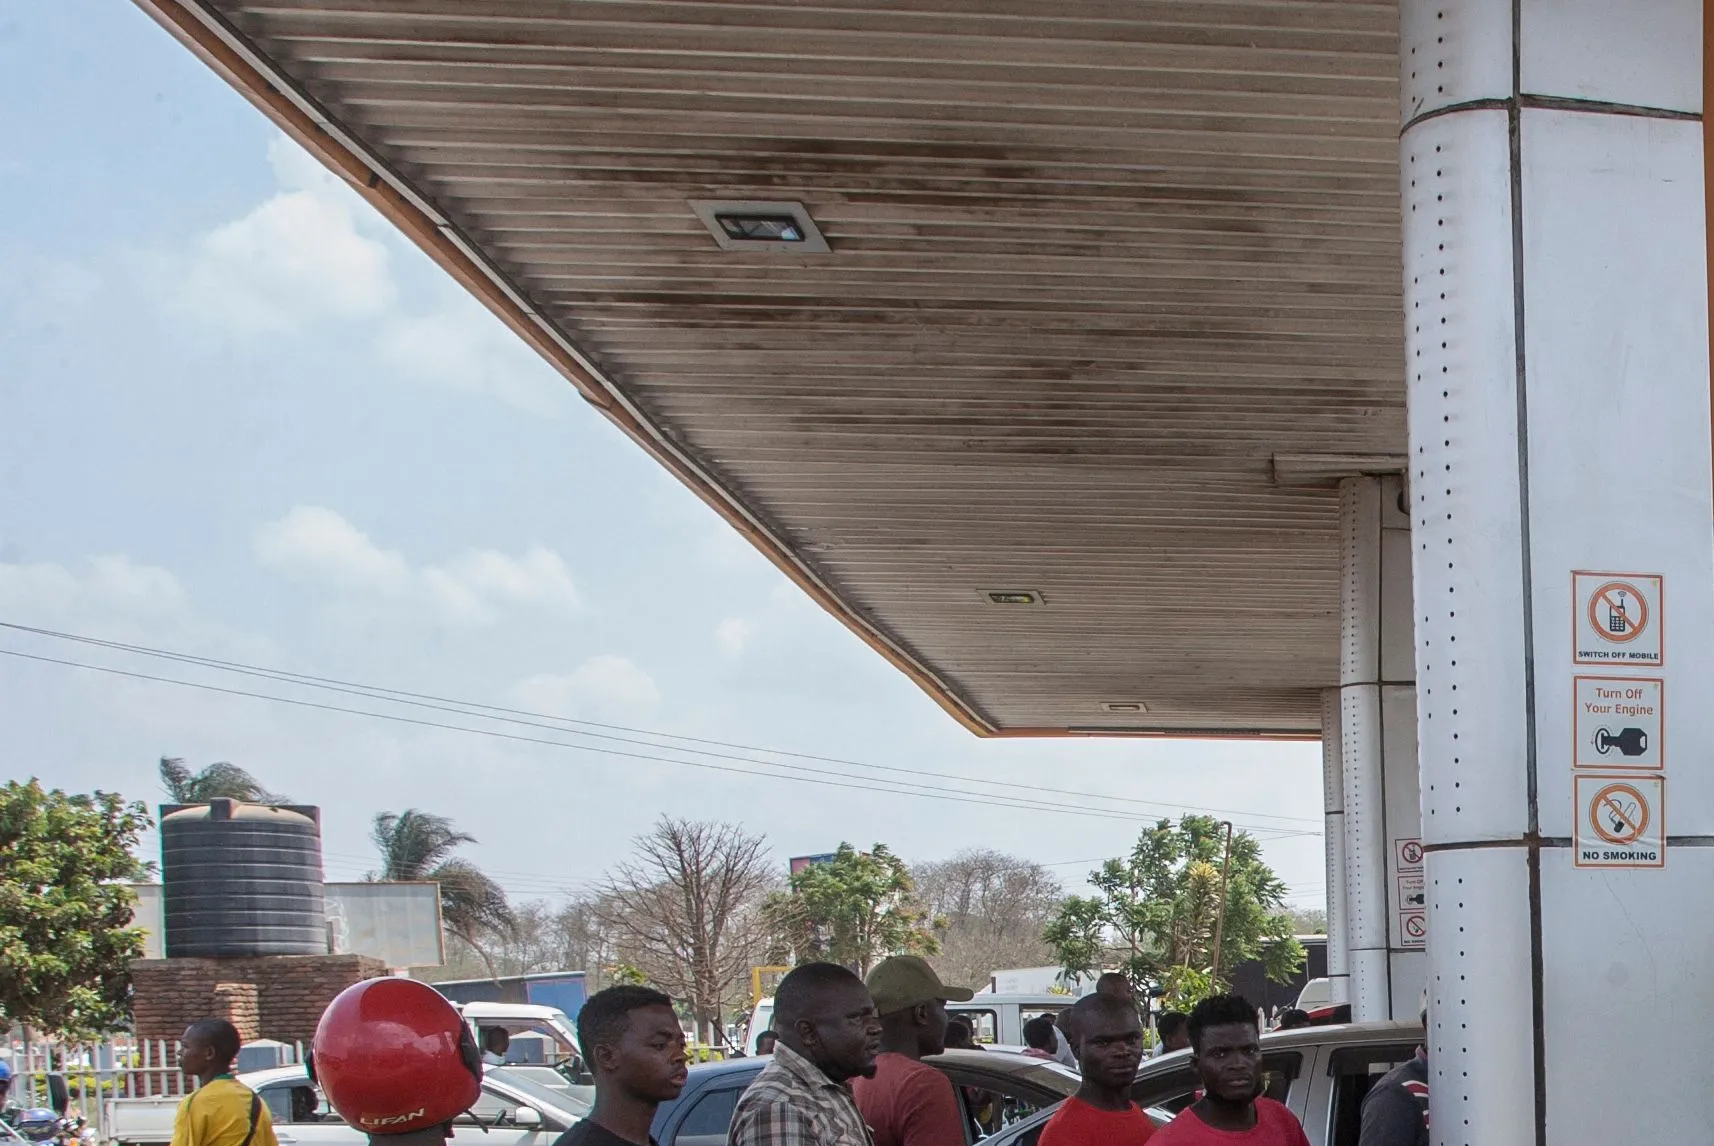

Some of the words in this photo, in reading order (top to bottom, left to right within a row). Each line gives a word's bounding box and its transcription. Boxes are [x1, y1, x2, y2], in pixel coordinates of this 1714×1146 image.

[1578, 650, 1609, 659] SWITCH
[1611, 651, 1626, 659] OFF
[1629, 652, 1659, 660] MOBILE
[1596, 687, 1622, 699] Turn
[1625, 688, 1643, 700] Off
[1584, 702, 1612, 714] Your
[1615, 703, 1654, 717] Engine
[1582, 851, 1599, 860] NO
[1603, 851, 1657, 861] SMOKING
[360, 1107, 425, 1125] LIFAN
